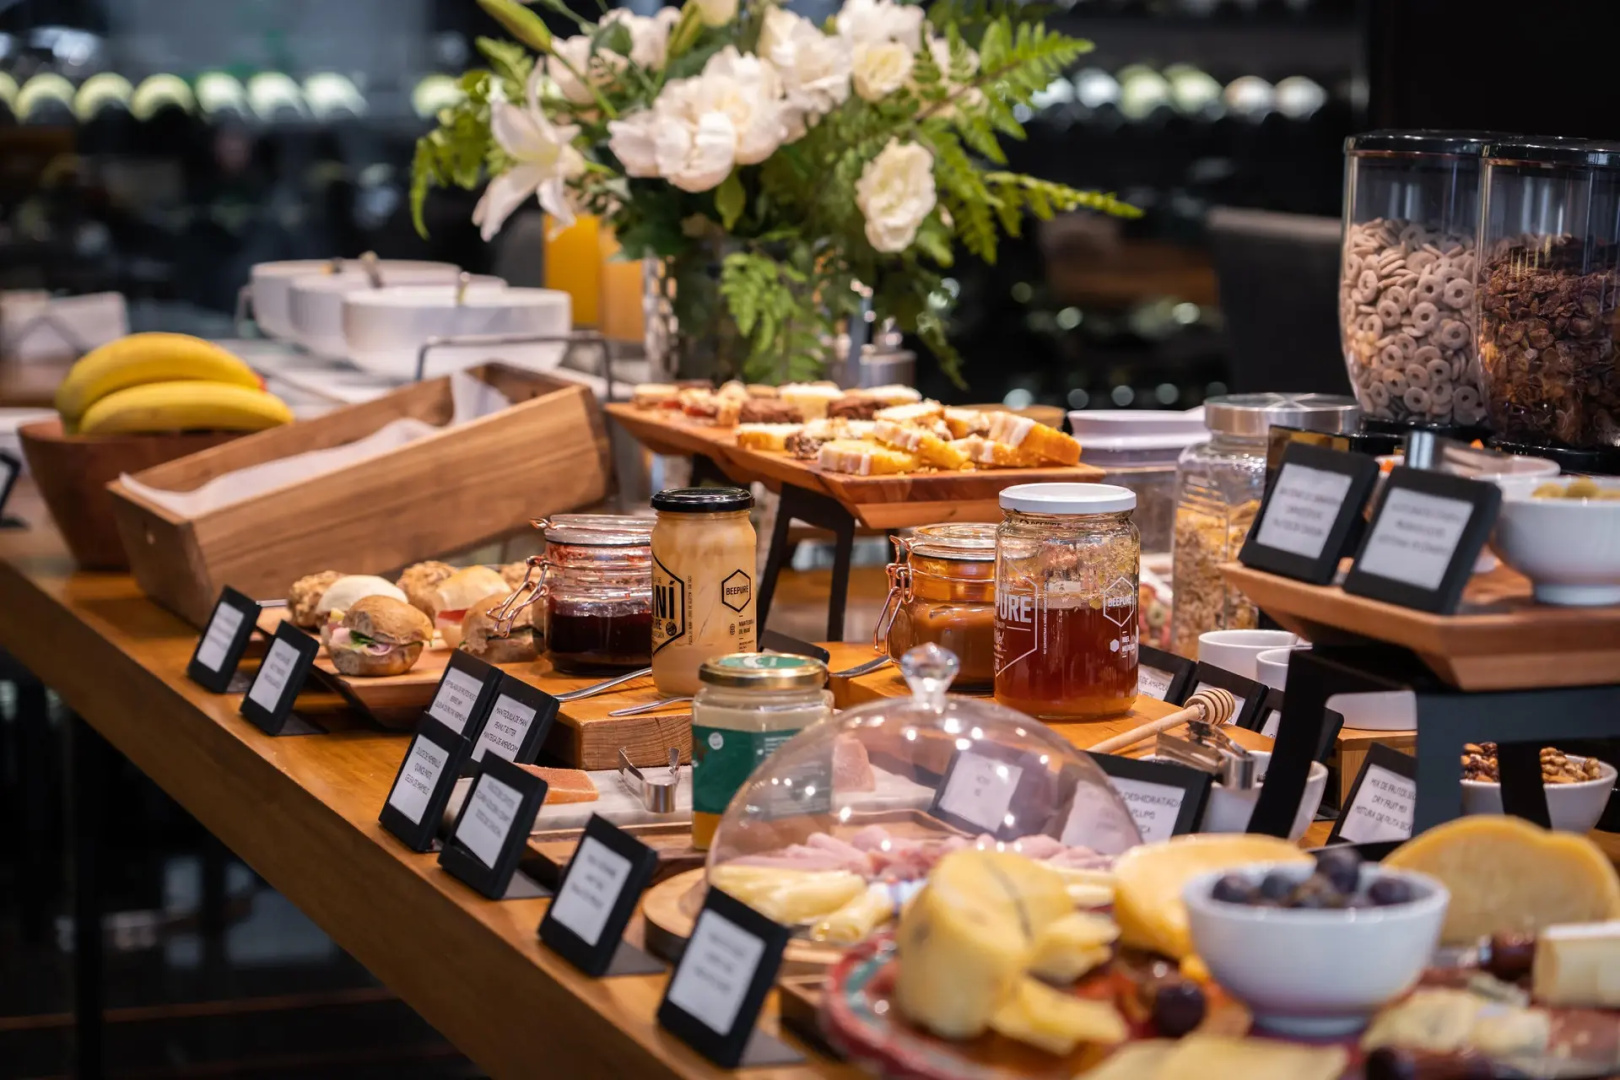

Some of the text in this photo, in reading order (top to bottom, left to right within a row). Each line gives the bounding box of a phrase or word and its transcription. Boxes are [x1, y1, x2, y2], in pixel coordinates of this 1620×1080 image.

[726, 585, 748, 595] BEEPURE
[653, 581, 675, 619] NÍ
[1108, 595, 1133, 607] BEEPURE
